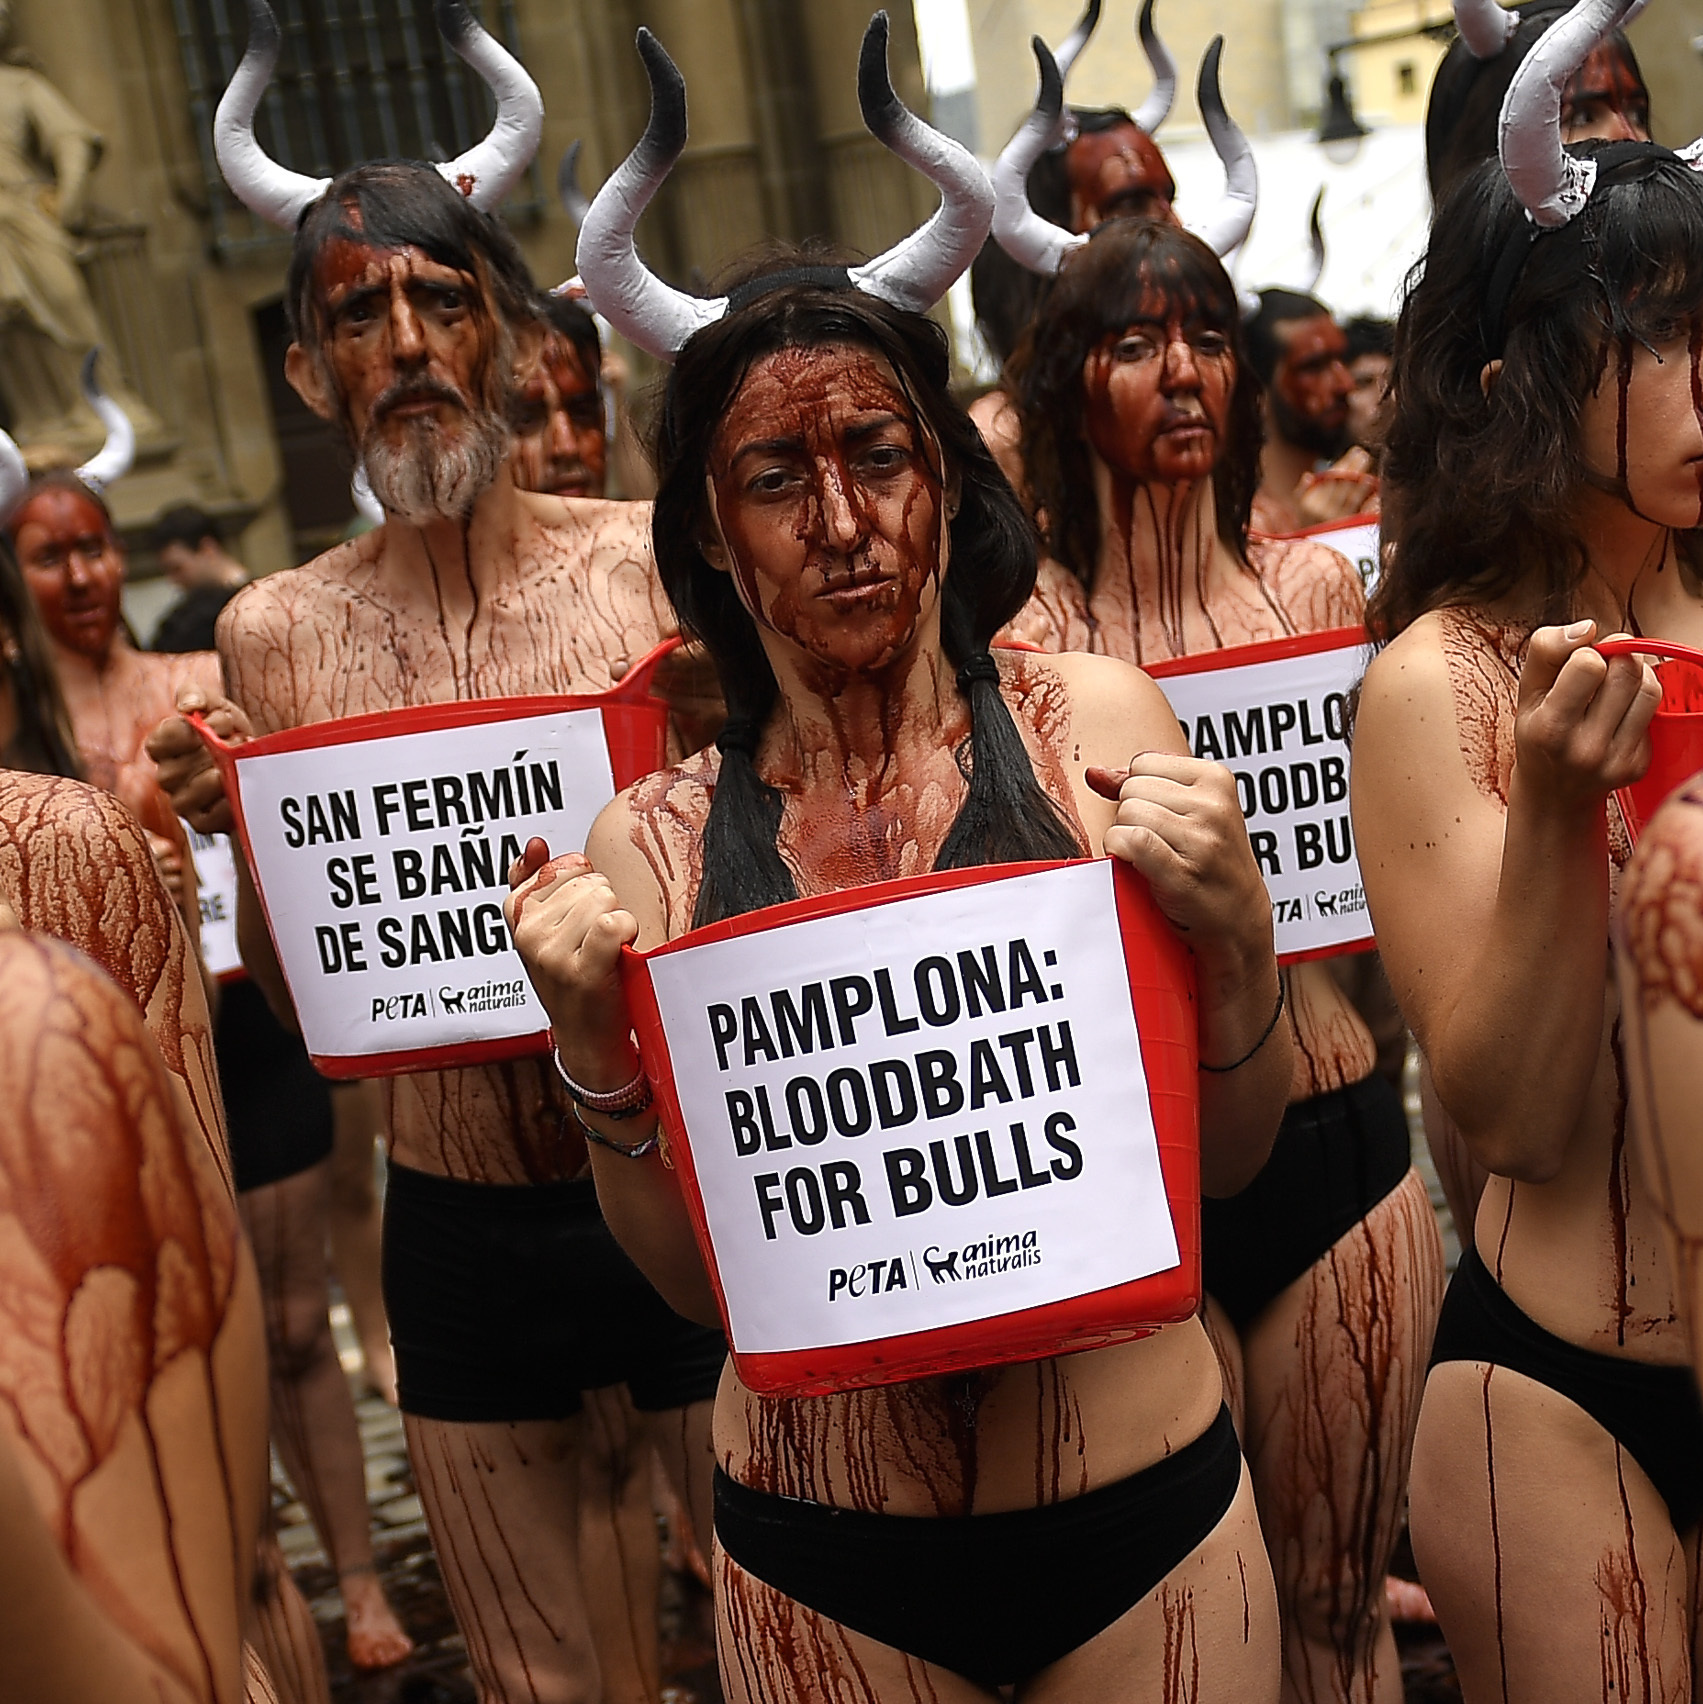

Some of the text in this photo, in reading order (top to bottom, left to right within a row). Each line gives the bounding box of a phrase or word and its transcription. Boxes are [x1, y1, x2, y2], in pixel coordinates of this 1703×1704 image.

[280, 750, 564, 849] SAN FERMÍN
[326, 853, 382, 909] SE
[315, 924, 368, 975] DE
[467, 979, 525, 1000] anima
[469, 993, 526, 1013] naturalis
[707, 938, 1065, 1071] PAMPLONA:
[725, 1020, 1082, 1157] BLOODBATH
[754, 1112, 1084, 1241] FOR BULLS
[962, 1230, 1037, 1262] anima
[965, 1249, 1041, 1280] naturalis
